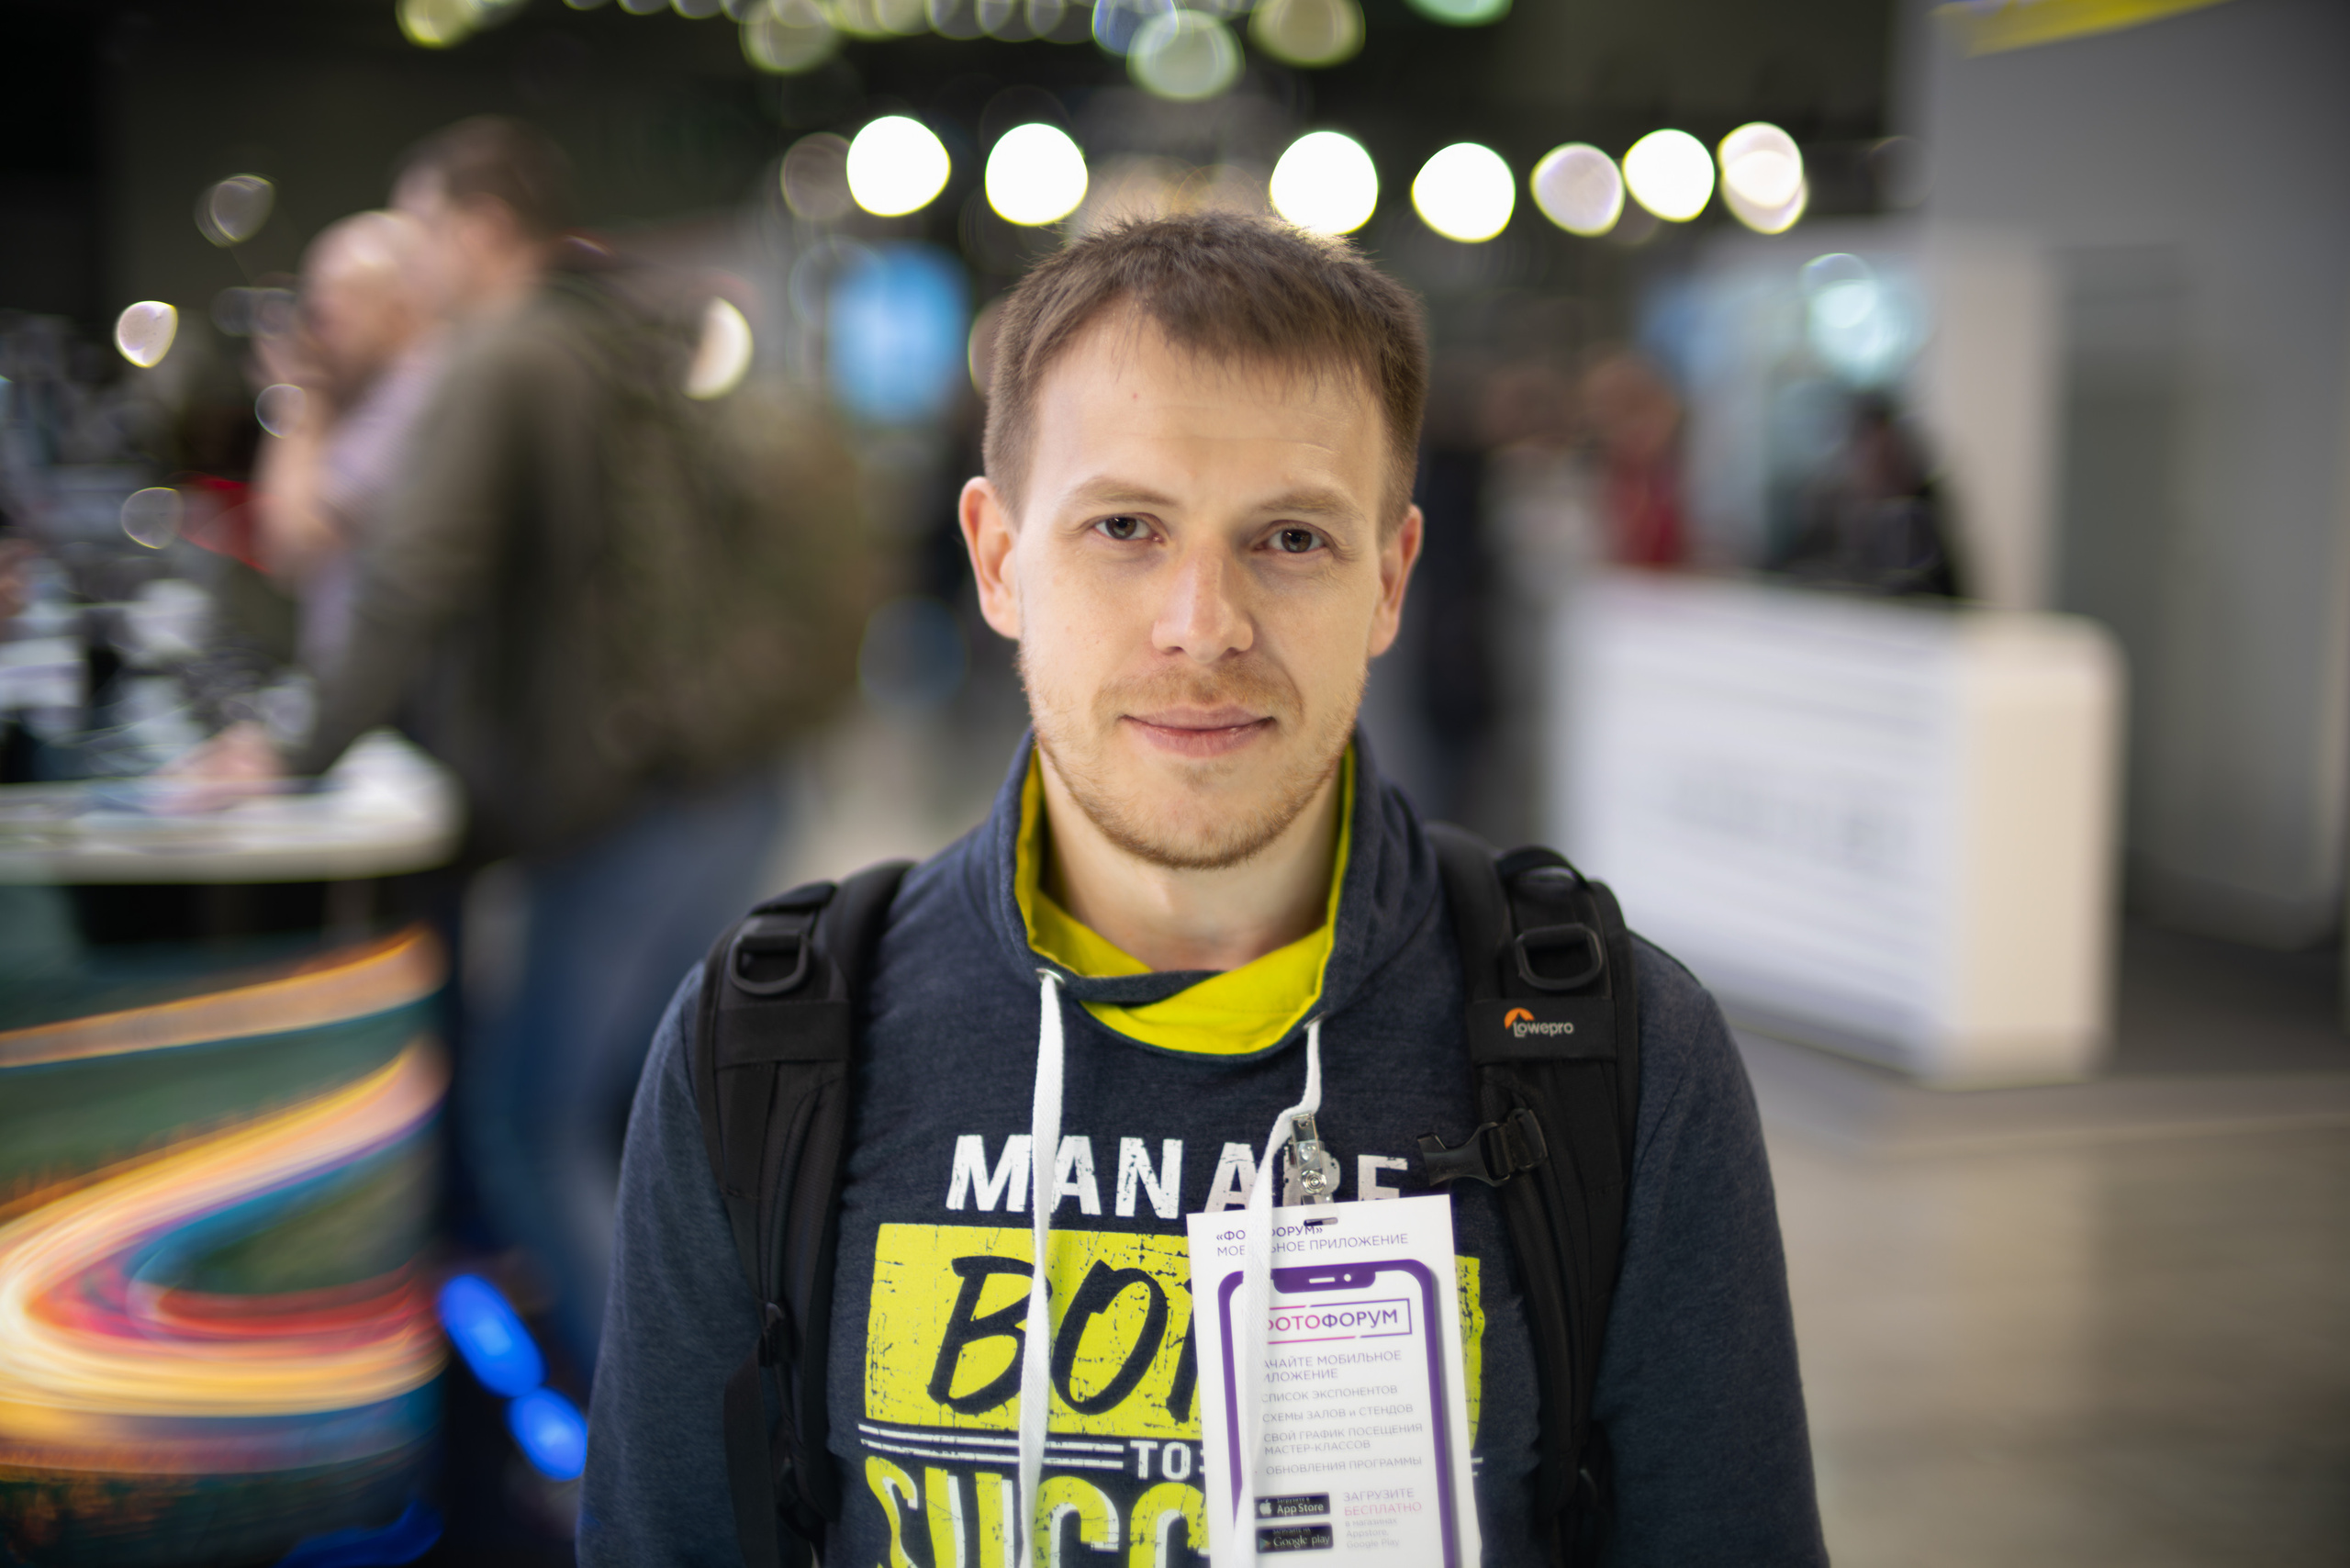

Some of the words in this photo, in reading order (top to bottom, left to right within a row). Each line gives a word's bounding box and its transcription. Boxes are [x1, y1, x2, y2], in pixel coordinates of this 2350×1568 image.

[1513, 1020, 1574, 1038] Lowepro
[1310, 1234, 1409, 1250] ПРИЛОЖЕНИЕ
[1317, 1350, 1402, 1367] МОБИЛЬНОЕ
[1312, 1384, 1398, 1399] ЭКСПОНЕНТОВ
[1262, 1411, 1304, 1423] СХЕМЫ
[1307, 1407, 1347, 1420] ЗАЛОВ
[1359, 1404, 1414, 1417] СТЕНДОВ
[1263, 1429, 1296, 1443] СВОЙ
[1300, 1428, 1345, 1439] ГРАФИК
[1348, 1423, 1423, 1438] ПОСЕЩЕНИЯ
[1264, 1439, 1371, 1455] МАСТЕР-КЛАССОВ
[1130, 1439, 1192, 1481] TO
[1266, 1461, 1346, 1476] ОБНОВЛЕНИЯ
[1349, 1456, 1423, 1471] ПРОГРАММЫ
[1343, 1487, 1415, 1502] ЗАГРУЗИТЕ
[1277, 1504, 1297, 1516] App
[1298, 1503, 1324, 1513] Store
[1344, 1501, 1422, 1517] БЕСПЛАТНО
[1273, 1535, 1307, 1549] Google
[1312, 1534, 1330, 1547] play
[1347, 1540, 1379, 1551] Google
[1382, 1538, 1400, 1548] Play
